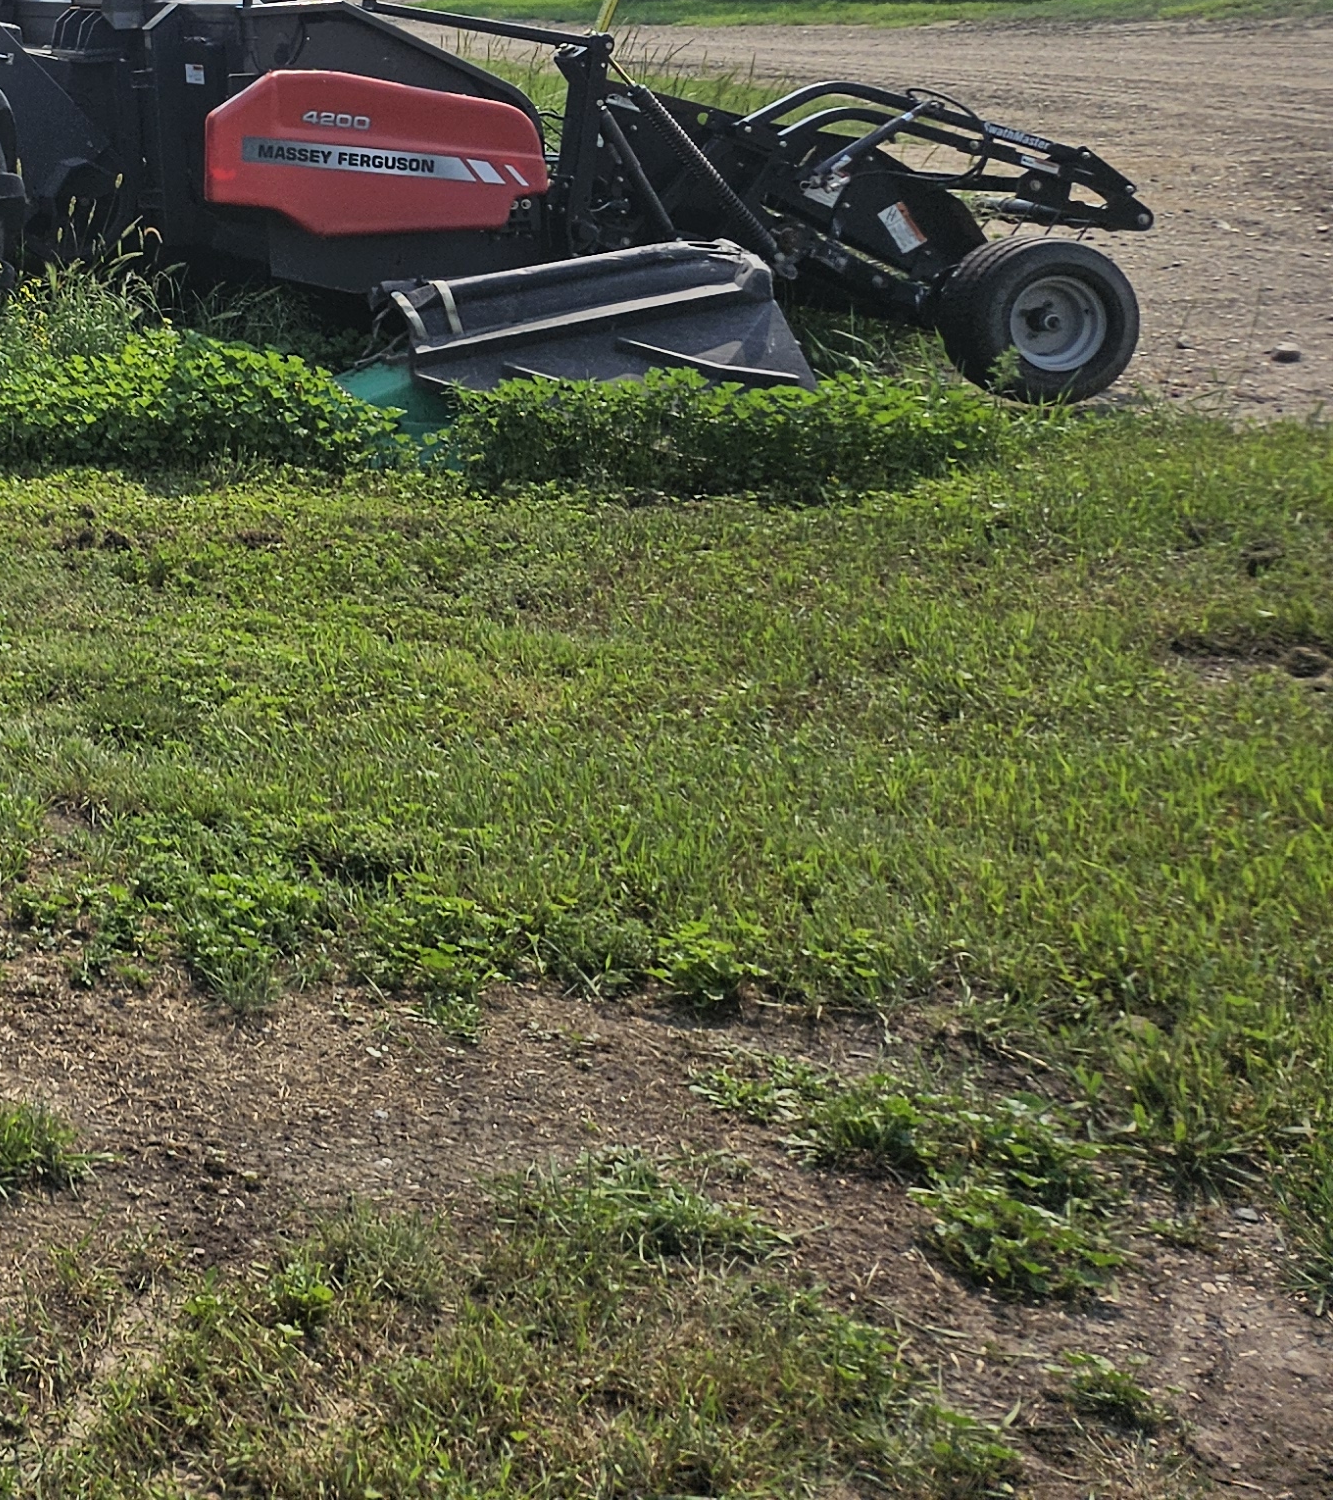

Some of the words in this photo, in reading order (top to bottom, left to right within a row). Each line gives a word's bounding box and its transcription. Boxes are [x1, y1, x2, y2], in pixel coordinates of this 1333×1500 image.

[302, 110, 371, 130] 4200
[258, 144, 332, 164] MASSEY
[338, 152, 435, 173] FERGUSON
